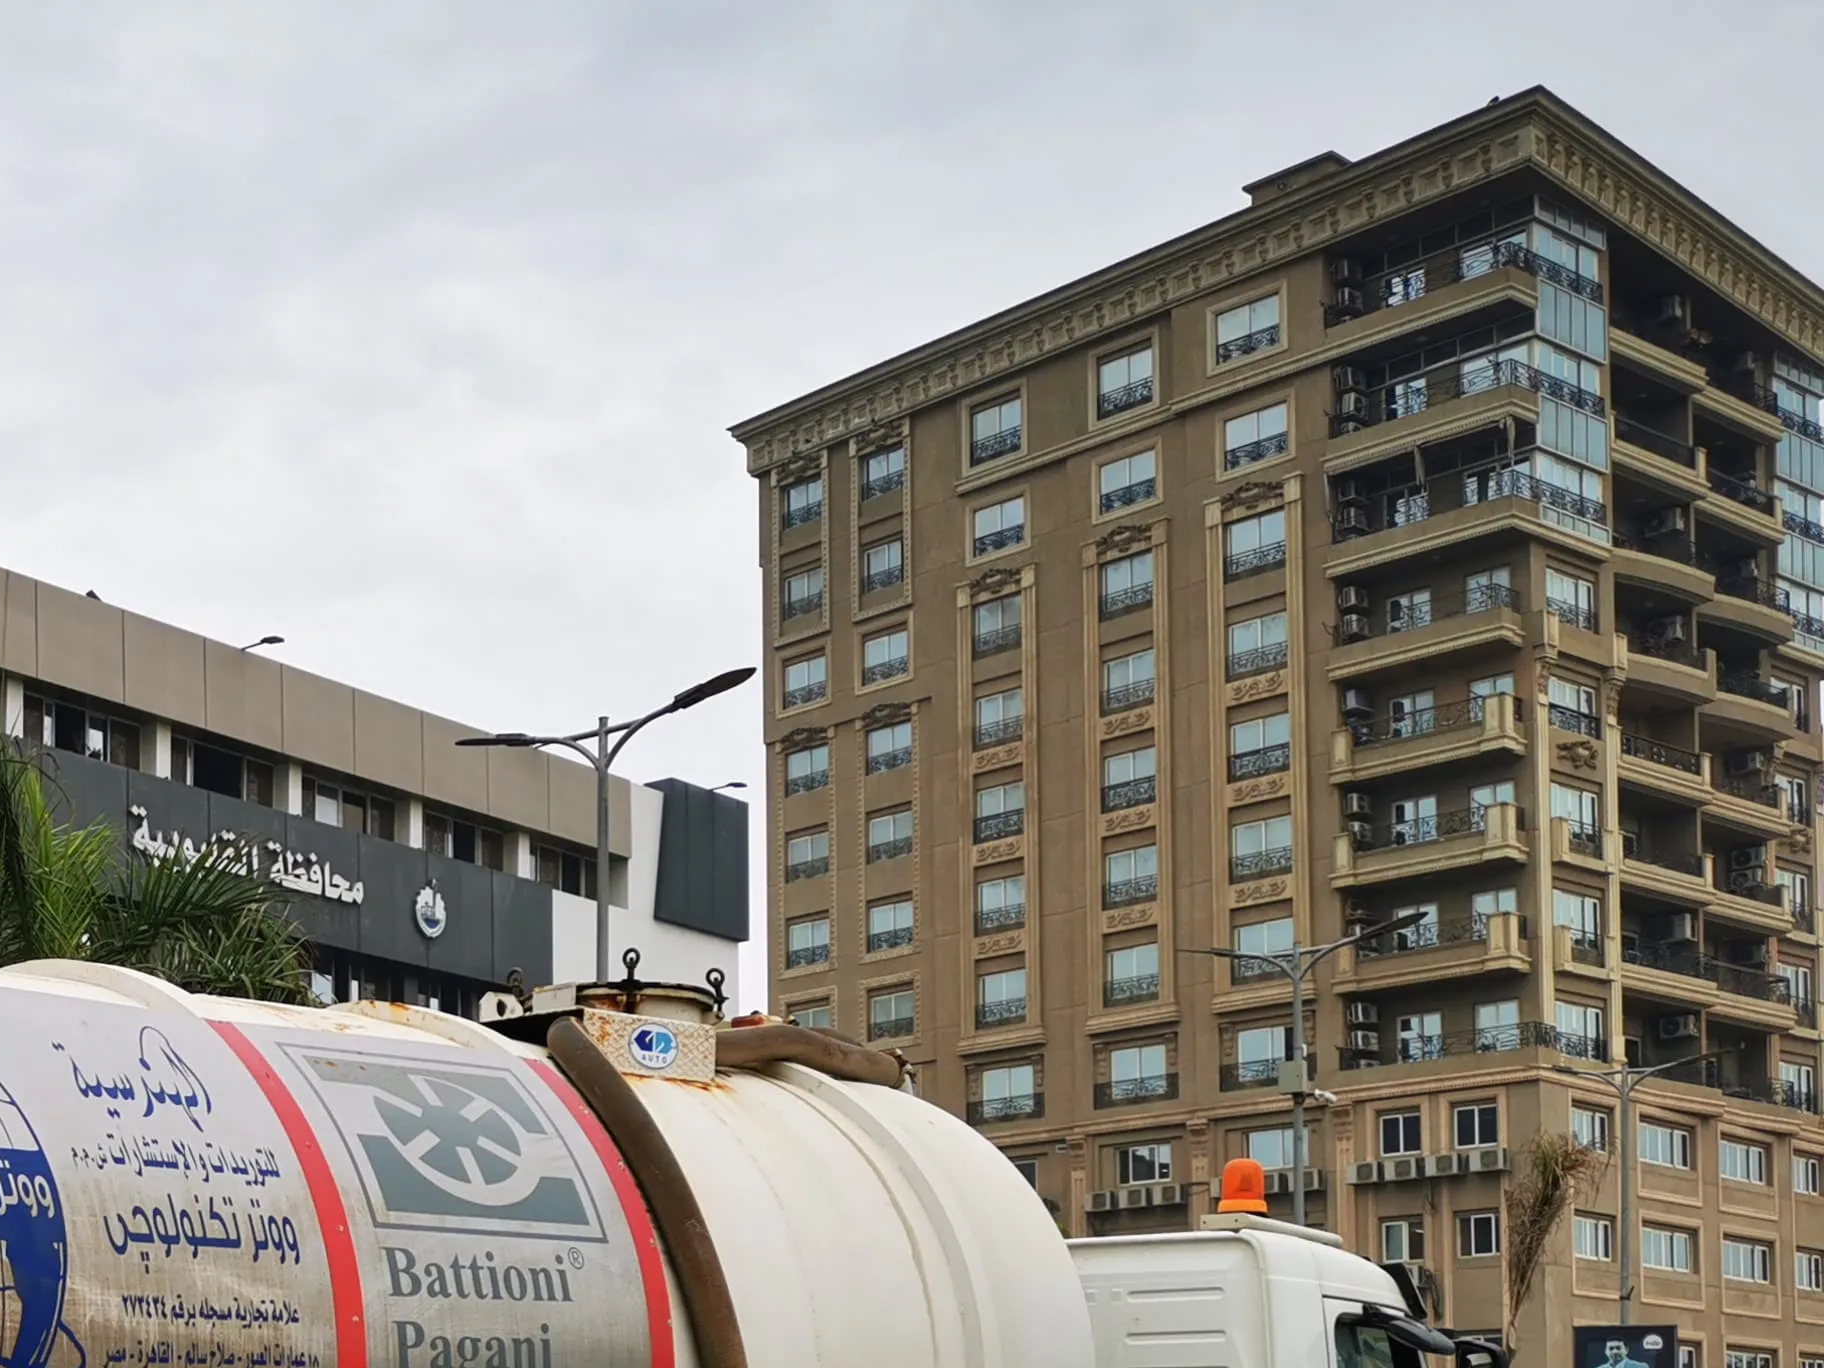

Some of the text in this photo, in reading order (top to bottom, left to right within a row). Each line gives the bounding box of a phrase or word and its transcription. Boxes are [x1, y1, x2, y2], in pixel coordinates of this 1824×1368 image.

[267, 840, 364, 904] محافظة
[208, 1143, 281, 1187] للتوريدات
[248, 1198, 301, 1265] ووتر
[170, 1294, 196, 1327] برقم
[234, 1297, 269, 1329] تجارية
[269, 1296, 300, 1325] علامة
